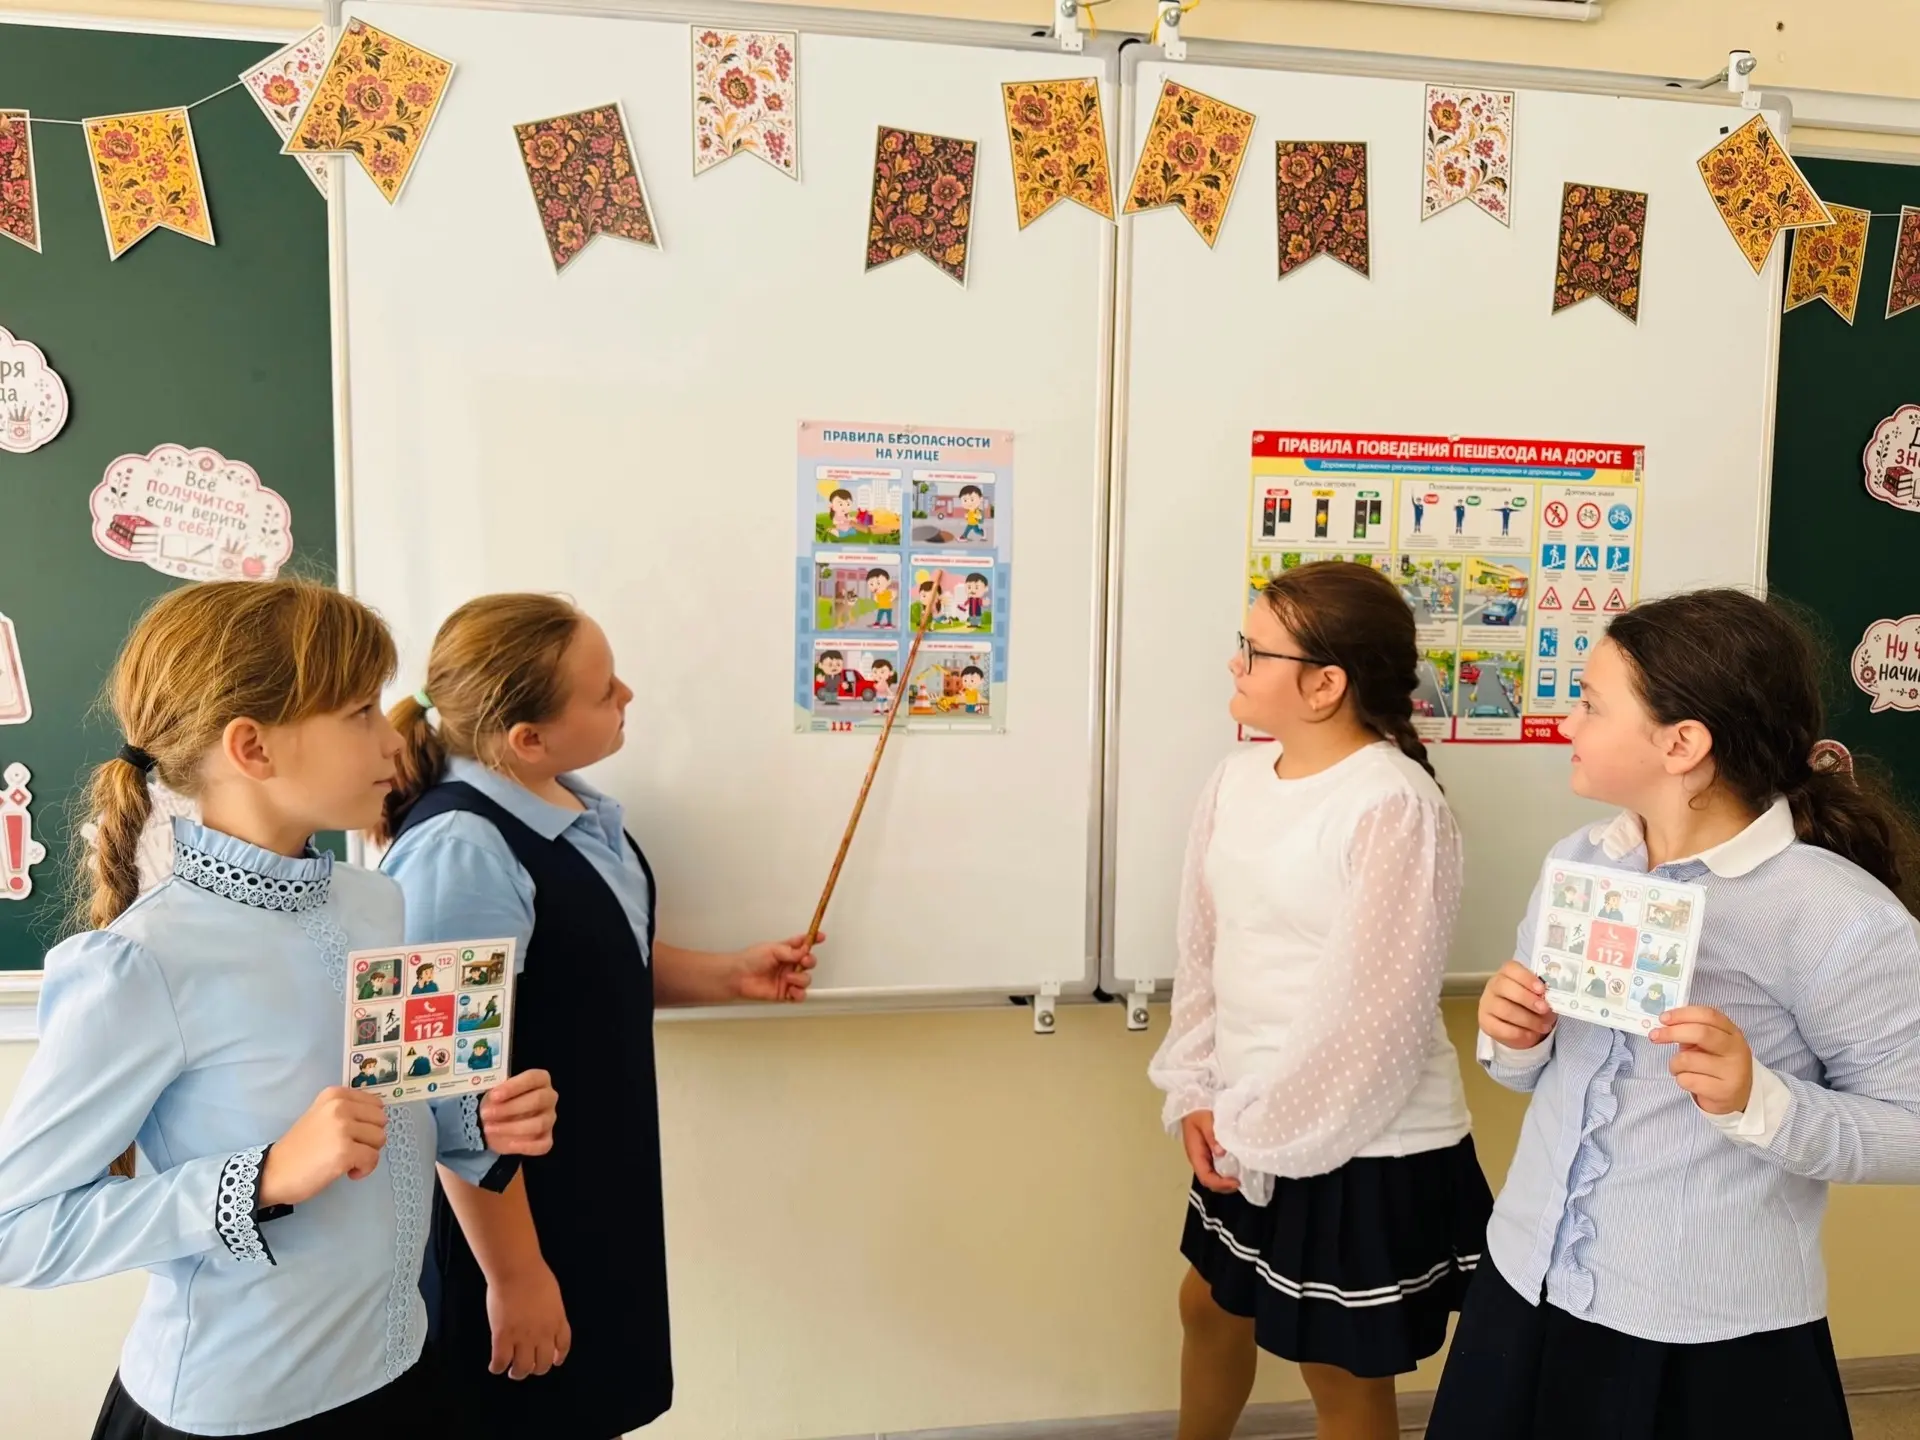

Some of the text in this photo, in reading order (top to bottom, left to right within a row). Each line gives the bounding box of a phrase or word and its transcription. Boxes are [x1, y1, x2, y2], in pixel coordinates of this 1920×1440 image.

[823, 430, 991, 448] ПРАВИЛА БЕЗОПАСНОСТИ
[875, 448, 939, 461] НА УЛИЦЕ
[1278, 437, 1622, 464] ПРАВИЛА ПОВЕДЕНИЯ ПЕШЕХОДА НА ДОРОГЕ
[146, 479, 249, 519] получится,
[146, 496, 246, 530] если верить
[163, 516, 222, 540] в себя!
[1886, 633, 1908, 662] Ну
[831, 721, 852, 731] 112
[1535, 728, 1551, 737] 102
[1624, 889, 1639, 899] 112
[438, 956, 452, 966] 112
[1595, 947, 1624, 966] 112
[414, 1021, 444, 1040] 112
